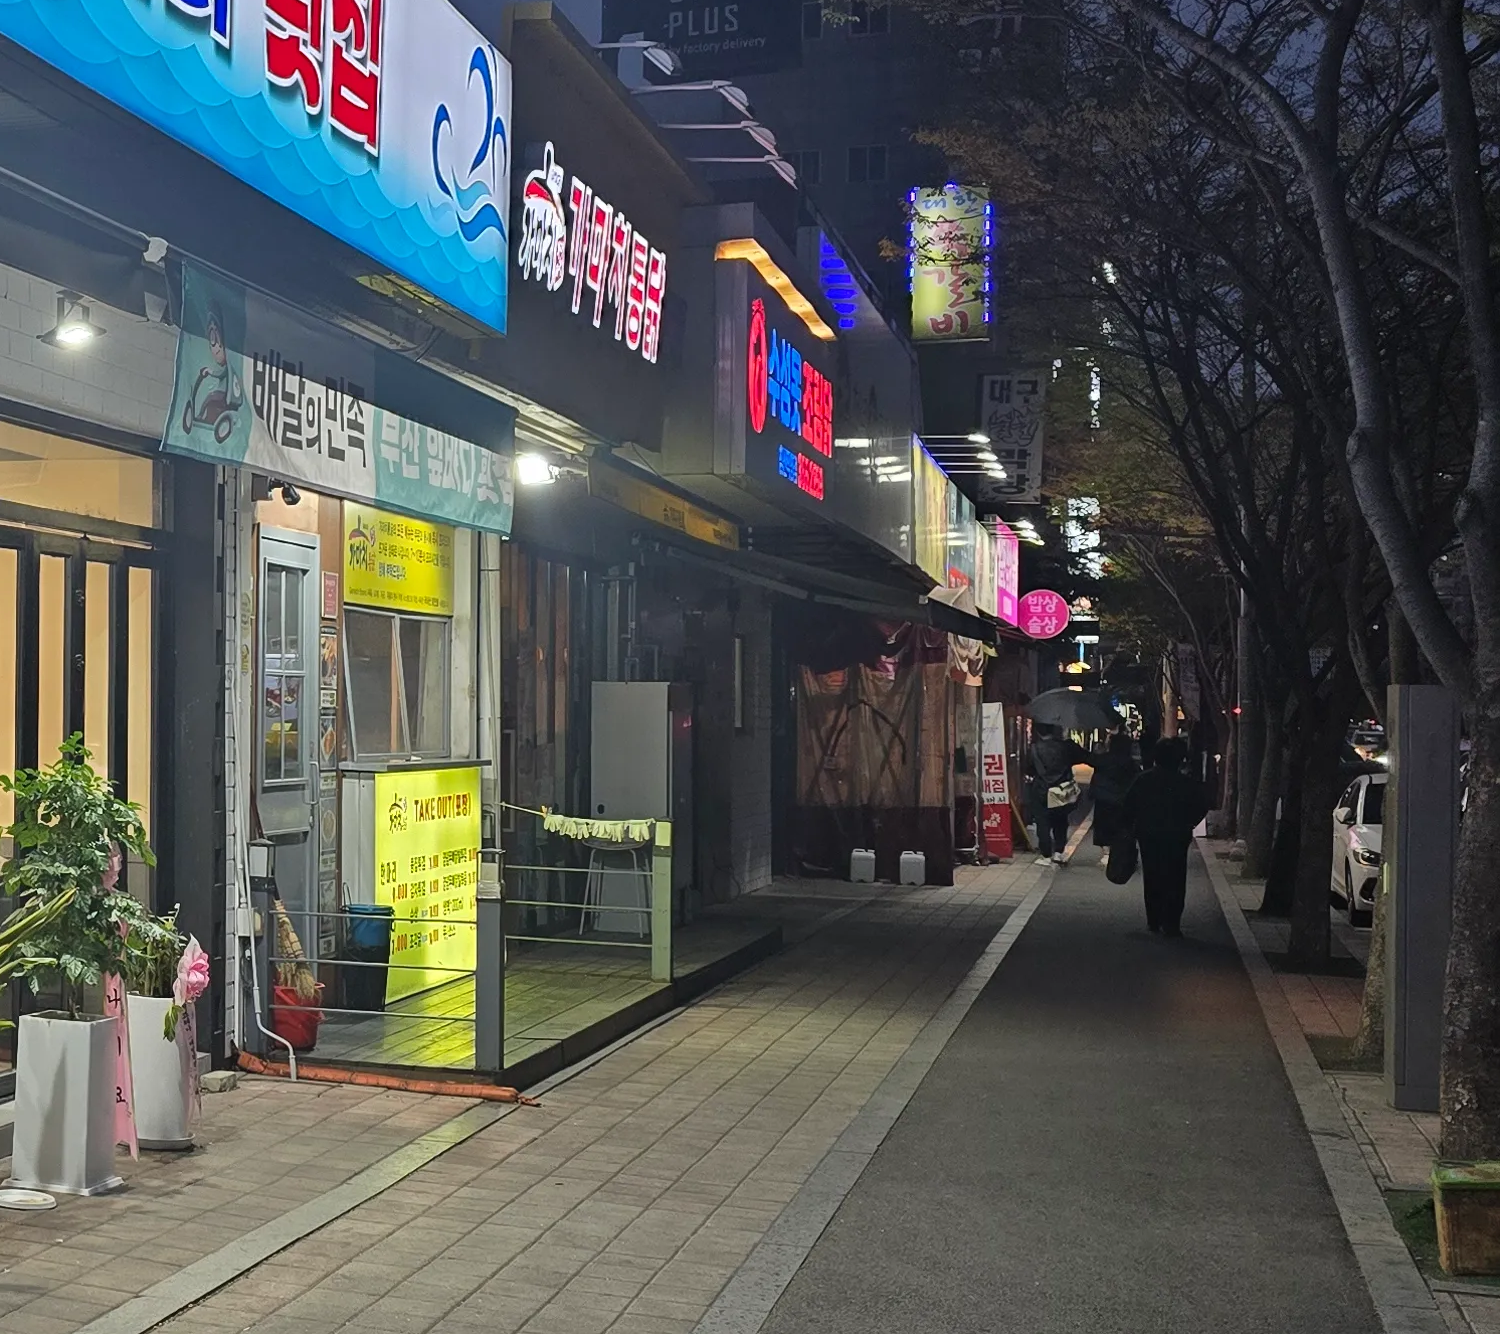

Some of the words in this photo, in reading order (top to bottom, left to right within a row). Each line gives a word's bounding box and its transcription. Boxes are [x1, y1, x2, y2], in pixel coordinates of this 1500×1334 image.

[668, 4, 739, 38] PLUS
[722, 36, 767, 51] delivery
[569, 175, 666, 364] 가마치통닭
[251, 349, 367, 468] 배달의민족
[380, 411, 420, 479] 부산
[427, 426, 476, 498] 앞바다
[1028, 595, 1058, 613] 밥상
[1028, 616, 1058, 634] 술상
[414, 798, 436, 823] TAKE
